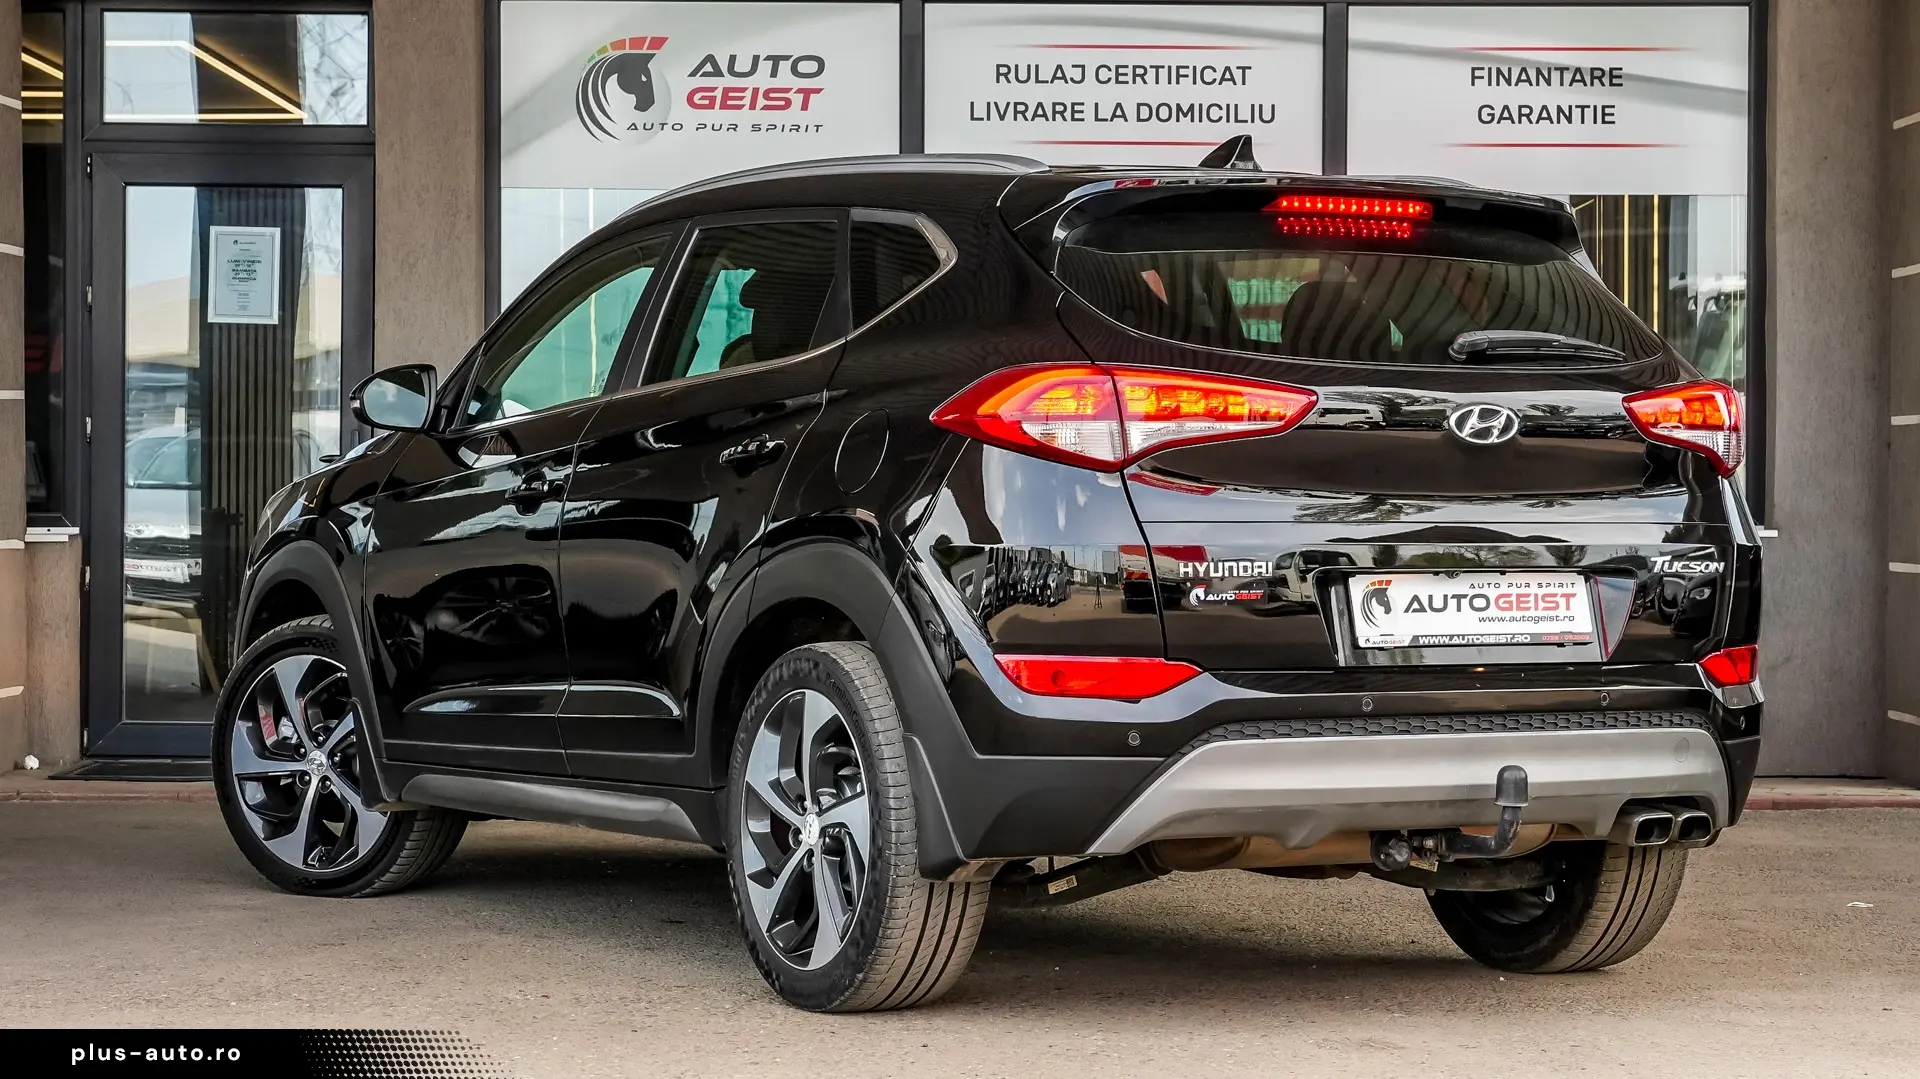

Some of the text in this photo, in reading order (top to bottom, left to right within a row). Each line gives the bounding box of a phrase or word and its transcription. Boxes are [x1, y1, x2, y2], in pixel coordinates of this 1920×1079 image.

[687, 53, 826, 79] AUTO
[995, 63, 1252, 86] RULAJ CERTIFICAT
[1470, 66, 1624, 87] FINANTARE
[686, 86, 825, 112] GEIST
[969, 101, 1277, 124] LIVRARE LA DOMICILIU
[1477, 104, 1616, 125] GARANTIE
[626, 122, 825, 134] AUTO PUR SPIRIT
[1179, 561, 1273, 578] HYUNDAI
[1468, 582, 1501, 590] AUTO
[1507, 582, 1532, 590] PUR
[1478, 614, 1575, 624] www.autogeist.ro
[1418, 634, 1531, 644] WWW.AUTOGEIST.RO
